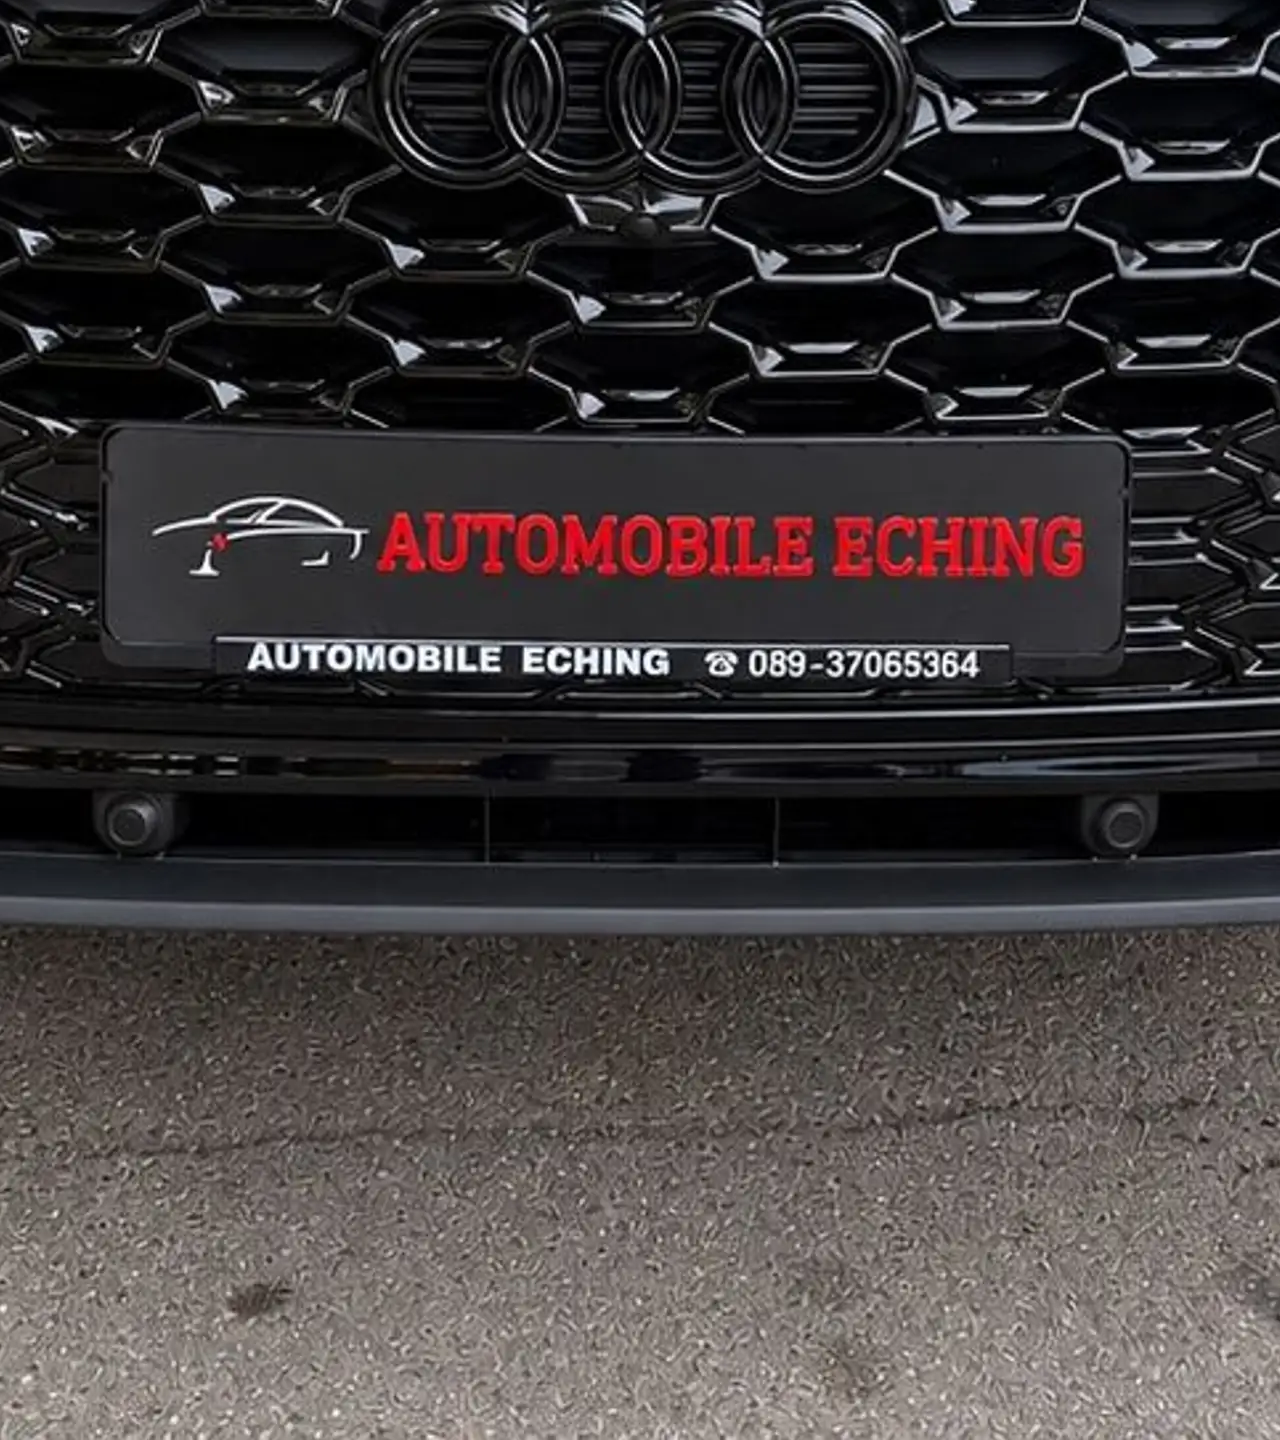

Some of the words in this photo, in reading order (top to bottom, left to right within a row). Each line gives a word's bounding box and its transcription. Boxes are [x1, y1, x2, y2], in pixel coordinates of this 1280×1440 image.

[376, 510, 816, 579] AUTOMOBILE
[832, 515, 1086, 579] ECHING
[246, 642, 502, 673] AUTOMOBILE
[522, 647, 670, 676] ECHING
[748, 649, 980, 678] 089-37065364
